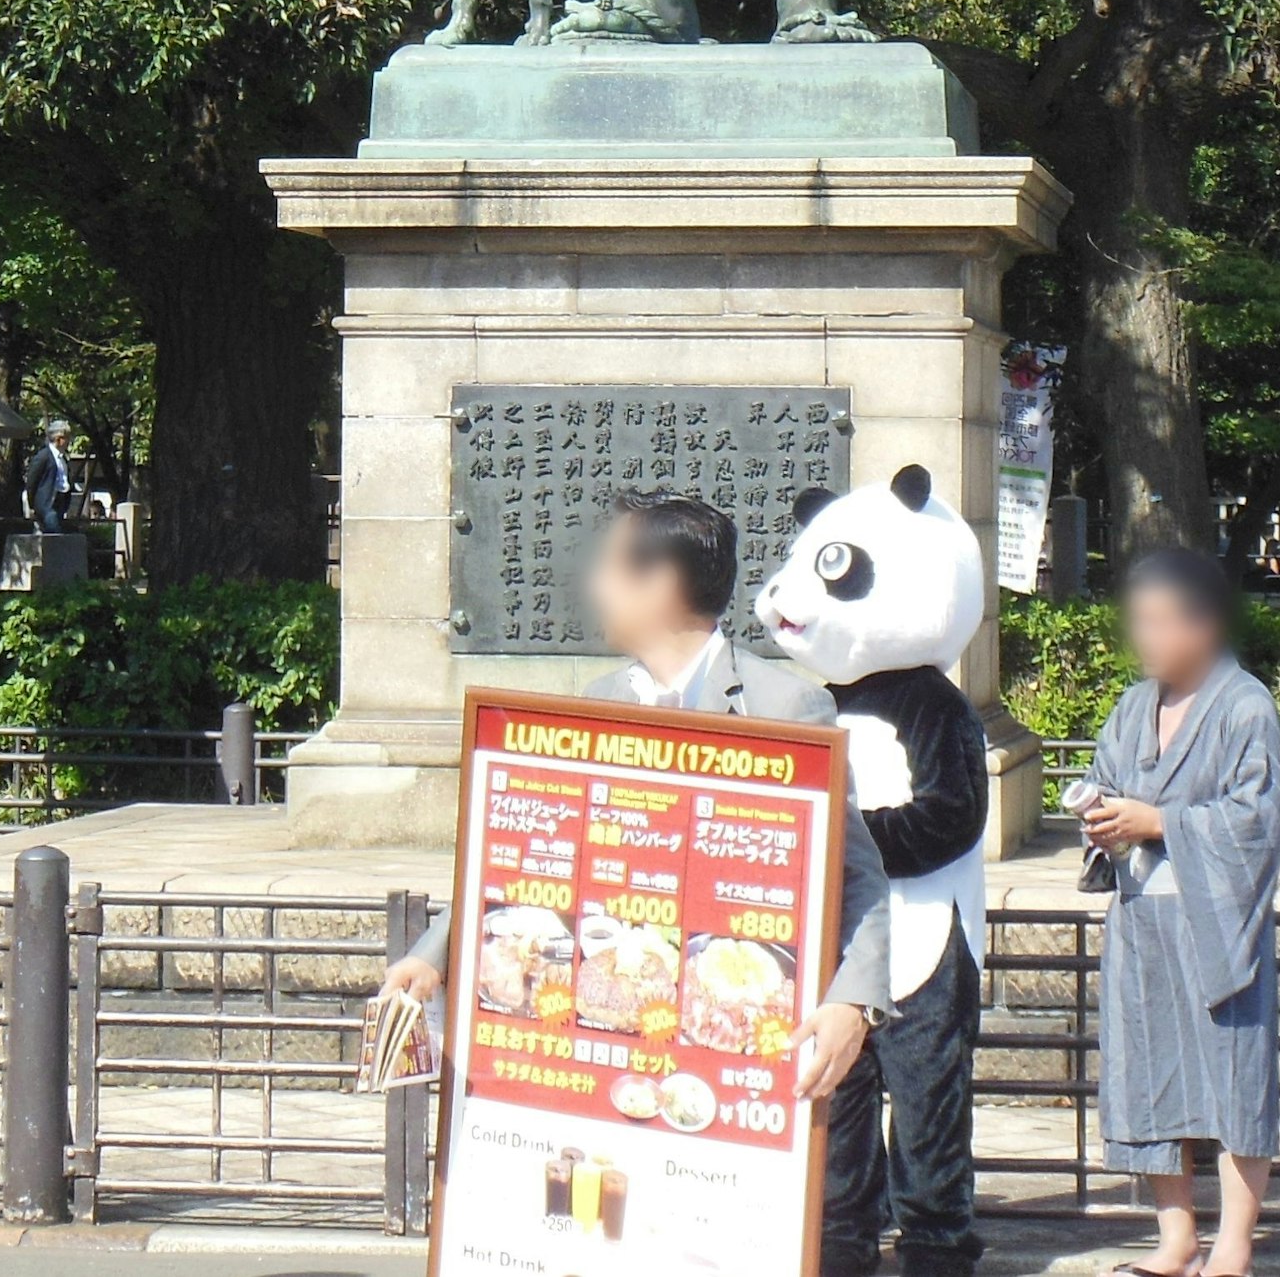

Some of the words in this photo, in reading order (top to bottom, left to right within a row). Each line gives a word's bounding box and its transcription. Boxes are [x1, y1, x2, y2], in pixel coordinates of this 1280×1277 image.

[504, 722, 590, 760] LUNCH
[594, 733, 674, 769] MENU
[677, 742, 795, 785] (17:00まで)
[490, 794, 580, 820] ワイルドジューシー
[589, 807, 649, 827] ビーフ100%
[489, 813, 558, 836] カットステーキ
[694, 839, 789, 867] ペッパーライス
[505, 878, 572, 910] ¥1,000
[606, 894, 677, 925] ¥1,000
[729, 910, 794, 942] ¥880
[476, 1022, 572, 1059] 店長おすすめ
[629, 1047, 677, 1076] セット
[492, 1058, 597, 1095] サラダ&おみそ汁
[720, 1099, 786, 1135] ¥100
[471, 1124, 507, 1146] Cold
[511, 1132, 555, 1155] Drink
[665, 1159, 738, 1188] Dessert
[463, 1243, 493, 1263] Hot
[499, 1250, 546, 1274] Drink
